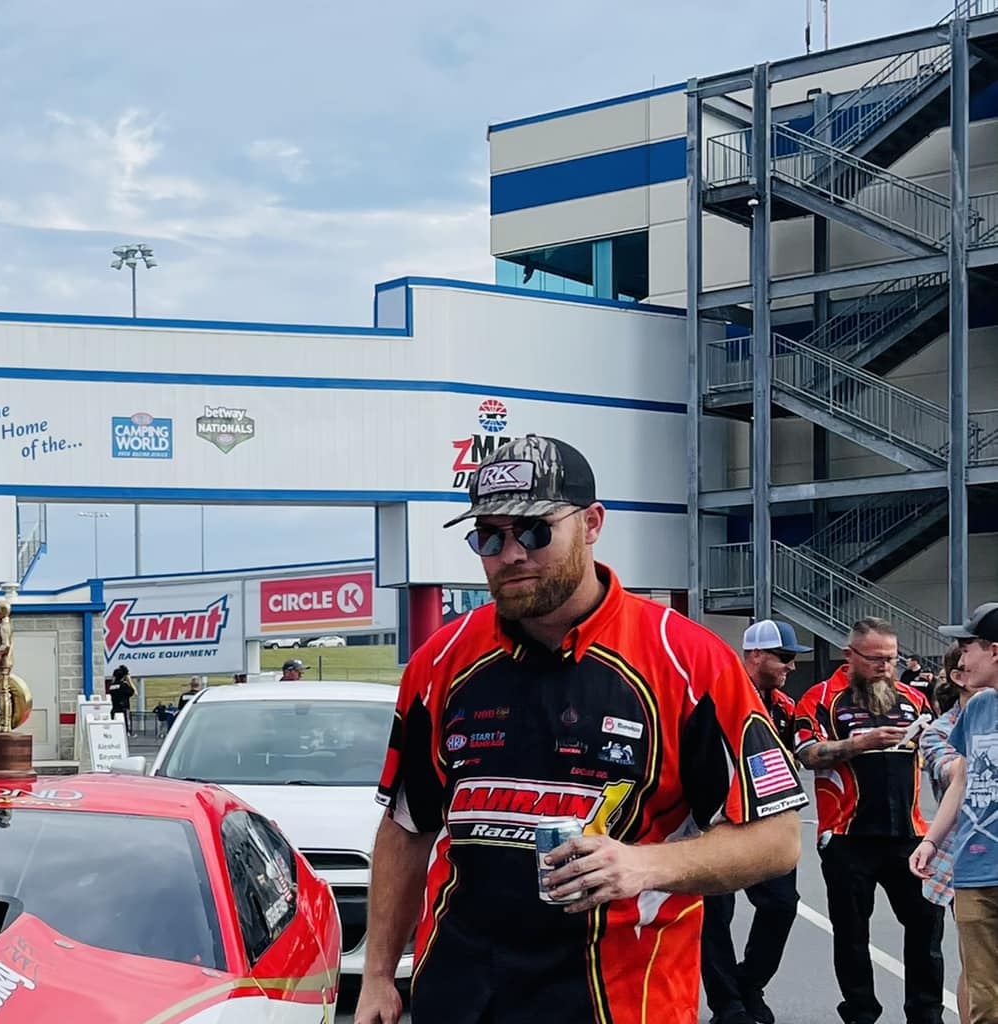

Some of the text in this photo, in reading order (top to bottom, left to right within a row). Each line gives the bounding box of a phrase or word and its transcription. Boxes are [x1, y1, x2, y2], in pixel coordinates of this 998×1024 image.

[204, 406, 246, 421] betway
[2, 420, 48, 439] Home
[114, 424, 170, 437] CAMPING
[197, 423, 254, 434] NATIONALS
[21, 436, 83, 460] of the...
[115, 436, 170, 451] WORLD
[268, 584, 363, 613] CIRCLE K
[117, 648, 219, 660] RACING EQUIPMENT
[450, 787, 594, 820] BAHRAIN
[470, 824, 536, 841] Racin
